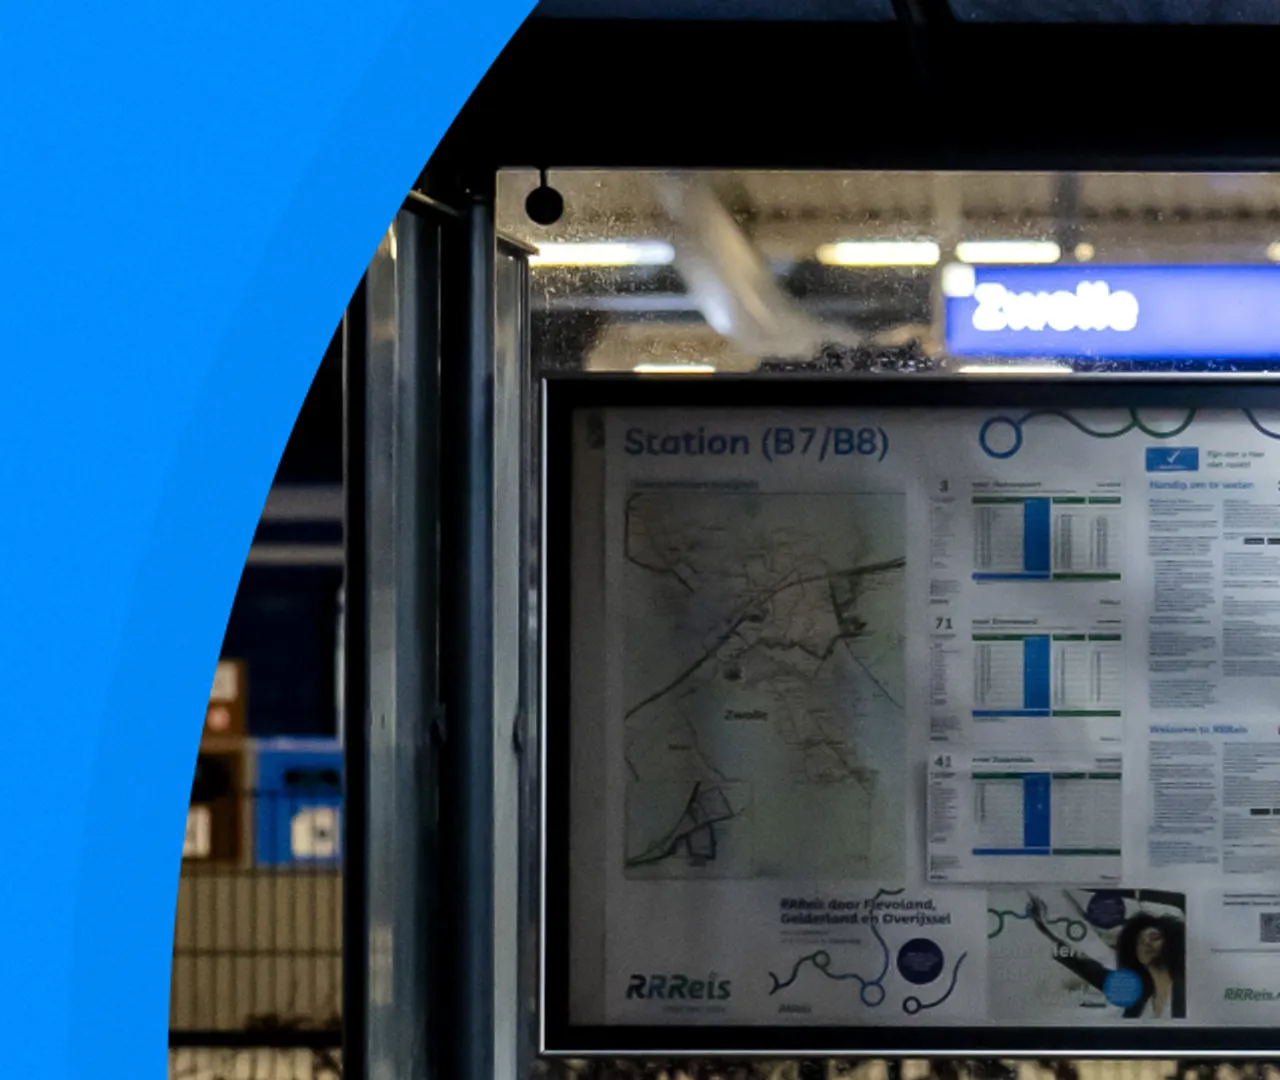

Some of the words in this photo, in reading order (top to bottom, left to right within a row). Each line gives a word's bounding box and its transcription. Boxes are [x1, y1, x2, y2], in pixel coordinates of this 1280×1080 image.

[972, 280, 1139, 332] Zwolle
[624, 427, 750, 456] Station
[762, 427, 890, 462] (B7/B8)
[935, 617, 953, 630] 71
[724, 709, 768, 721] Zwolle
[934, 755, 952, 768] 41
[828, 898, 860, 910] door
[864, 898, 936, 913] Flevoland,
[780, 912, 860, 925] Gelderland
[882, 912, 952, 927] Overijssel
[625, 970, 732, 1000] RRReis
